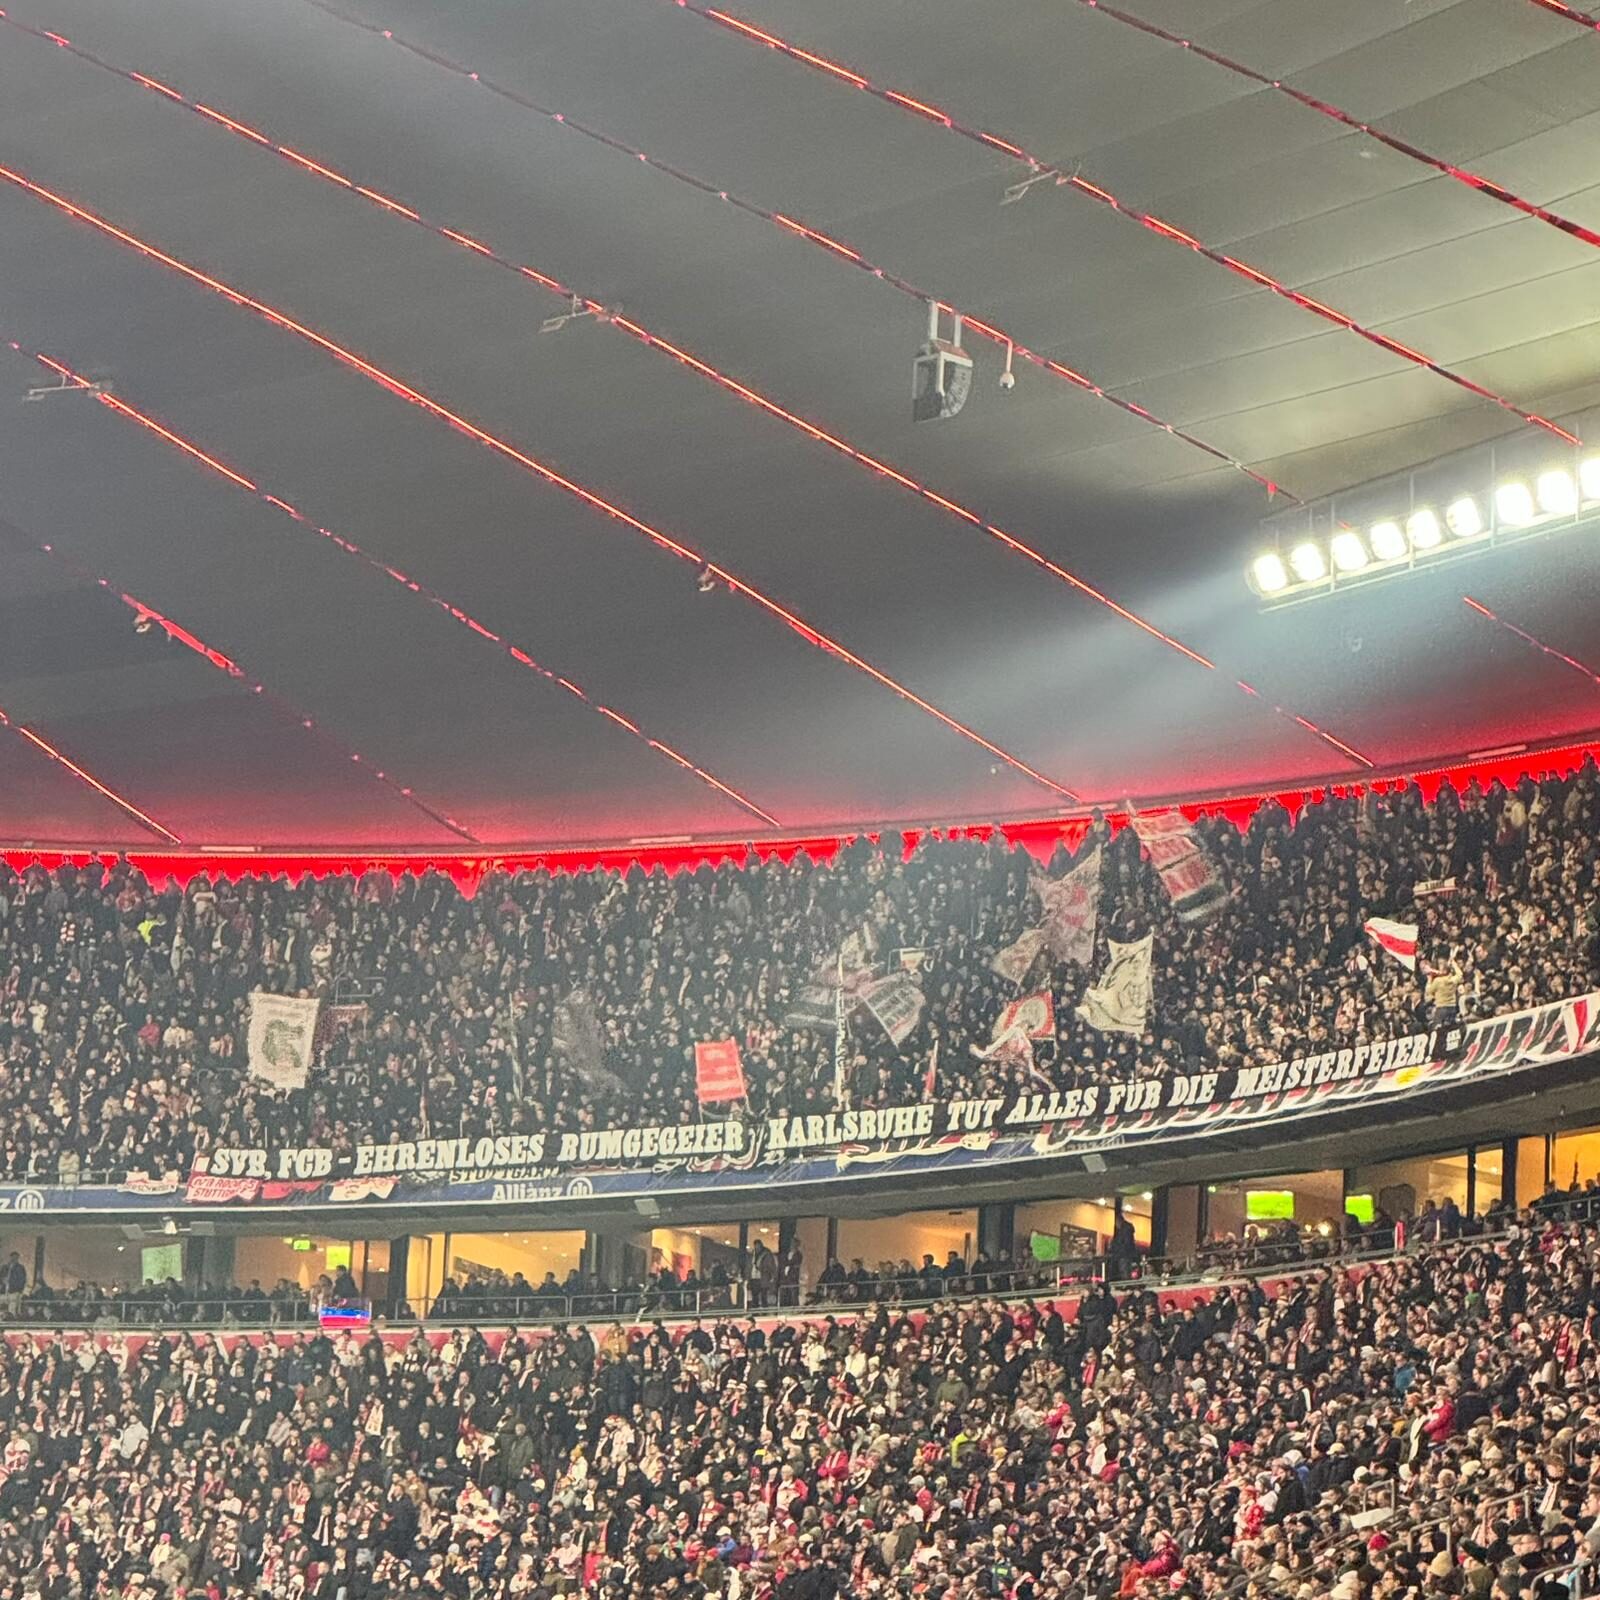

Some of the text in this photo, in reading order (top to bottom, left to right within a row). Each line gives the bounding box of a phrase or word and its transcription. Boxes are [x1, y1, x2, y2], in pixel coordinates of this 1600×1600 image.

[277, 1148, 333, 1179] FCB
[353, 1133, 545, 1175] EHRENLOSES
[767, 1104, 934, 1150] KARLSRUHE
[947, 1100, 1004, 1132] TUT
[1004, 1085, 1100, 1125] ALLES
[1103, 1074, 1162, 1117] FÜR
[1166, 1072, 1219, 1107] DIE
[1230, 1030, 1436, 1101] MEISTERFEIER!
[492, 1182, 563, 1201] Allianz
